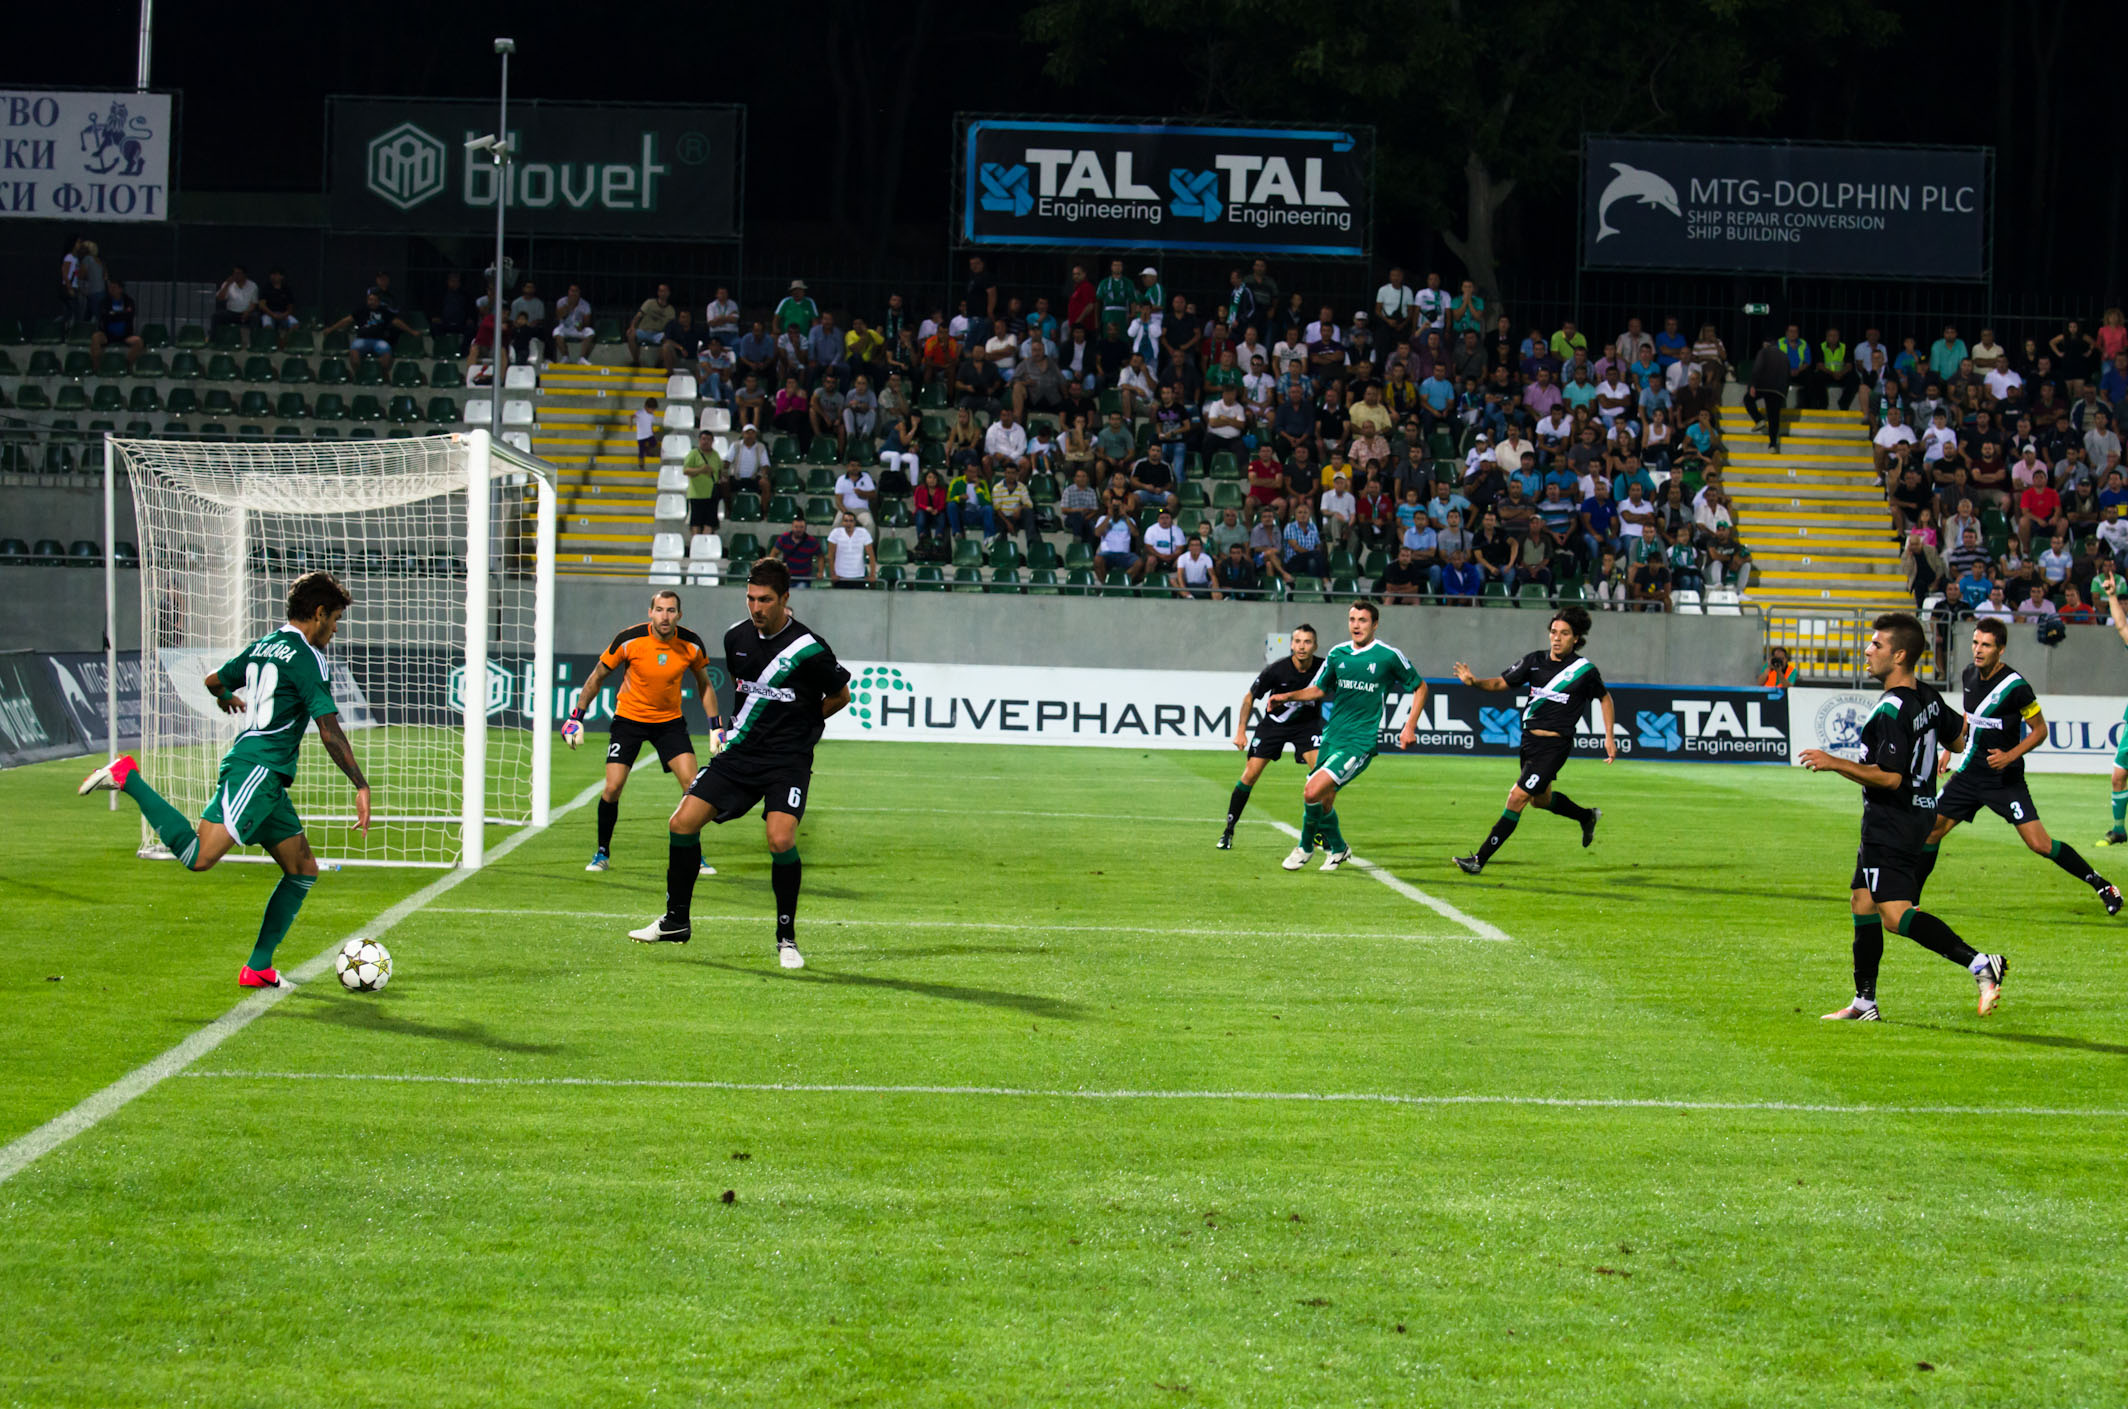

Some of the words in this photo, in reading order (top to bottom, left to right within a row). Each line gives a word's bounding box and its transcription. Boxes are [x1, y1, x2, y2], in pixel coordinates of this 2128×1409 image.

[0, 96, 59, 127] ВО
[464, 131, 666, 208] biovet
[1025, 148, 1160, 200] TAL
[1215, 154, 1350, 207] TAL
[52, 183, 162, 215] ФЛОТ
[1689, 178, 1910, 212] MTG-DOLPHIN
[1922, 185, 1974, 213] PLC
[1038, 198, 1162, 224] Engineering
[1228, 204, 1351, 231] Engineering
[1687, 210, 1722, 225] SHIP
[1727, 211, 1780, 227] REPAIR
[1784, 213, 1885, 231] CONVERSION
[1687, 225, 1722, 240] SHIP
[1727, 226, 1801, 243] BUILDING
[1672, 700, 1786, 738] TAL
[1685, 737, 1787, 756] Engineering
[1525, 774, 1540, 789] 8
[787, 786, 802, 808] 6
[2010, 801, 2024, 820] 3
[1862, 867, 1880, 892] 17
